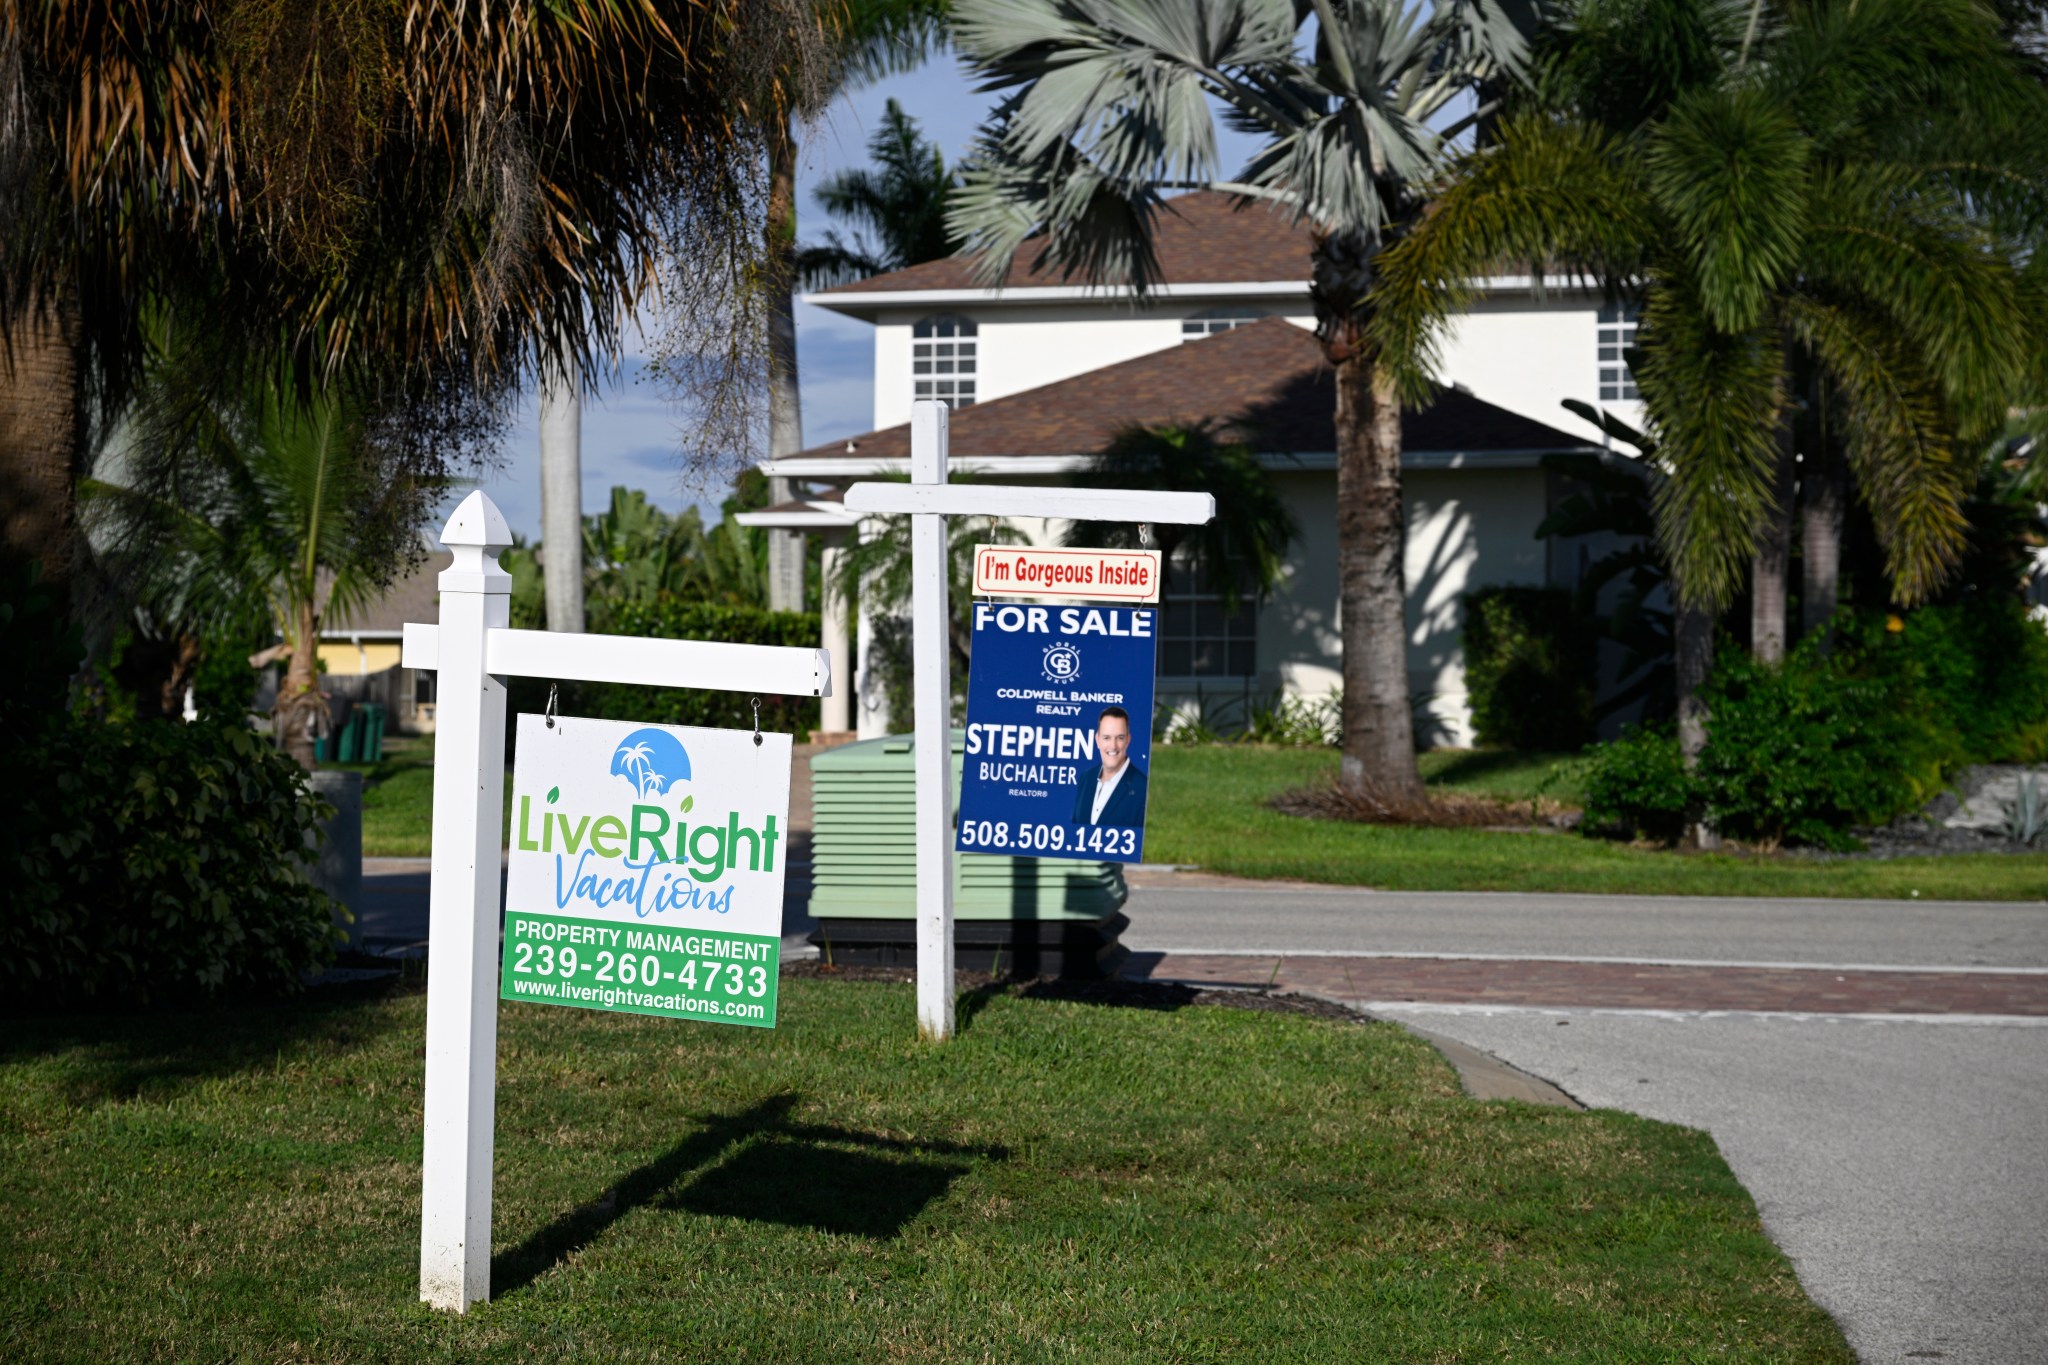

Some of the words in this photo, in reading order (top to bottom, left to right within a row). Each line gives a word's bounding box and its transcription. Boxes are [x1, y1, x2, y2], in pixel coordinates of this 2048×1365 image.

[985, 556, 1009, 580] I'm
[1015, 557, 1093, 587] Gorgeous
[1099, 560, 1149, 586] Inside
[976, 605, 1050, 634] FOR
[1060, 609, 1152, 637] SALE
[1042, 641, 1081, 655] GLOBAL
[1041, 671, 1081, 685] LUXURY
[996, 688, 1067, 702] COLDWELL
[1070, 691, 1123, 704] BANKER
[1036, 704, 1081, 716] REALTY
[966, 723, 1095, 760] STEPHEN
[979, 762, 1078, 785] BUCHALTER
[518, 786, 779, 883] LiveRight
[961, 820, 1136, 855] 508.509.1423
[556, 848, 735, 918] Vacations
[515, 919, 621, 947] PROPERTY
[627, 931, 772, 962] MANAGEMENT
[513, 943, 767, 997] 239-260-4733
[514, 980, 764, 1018] www.liverightvacations.com
